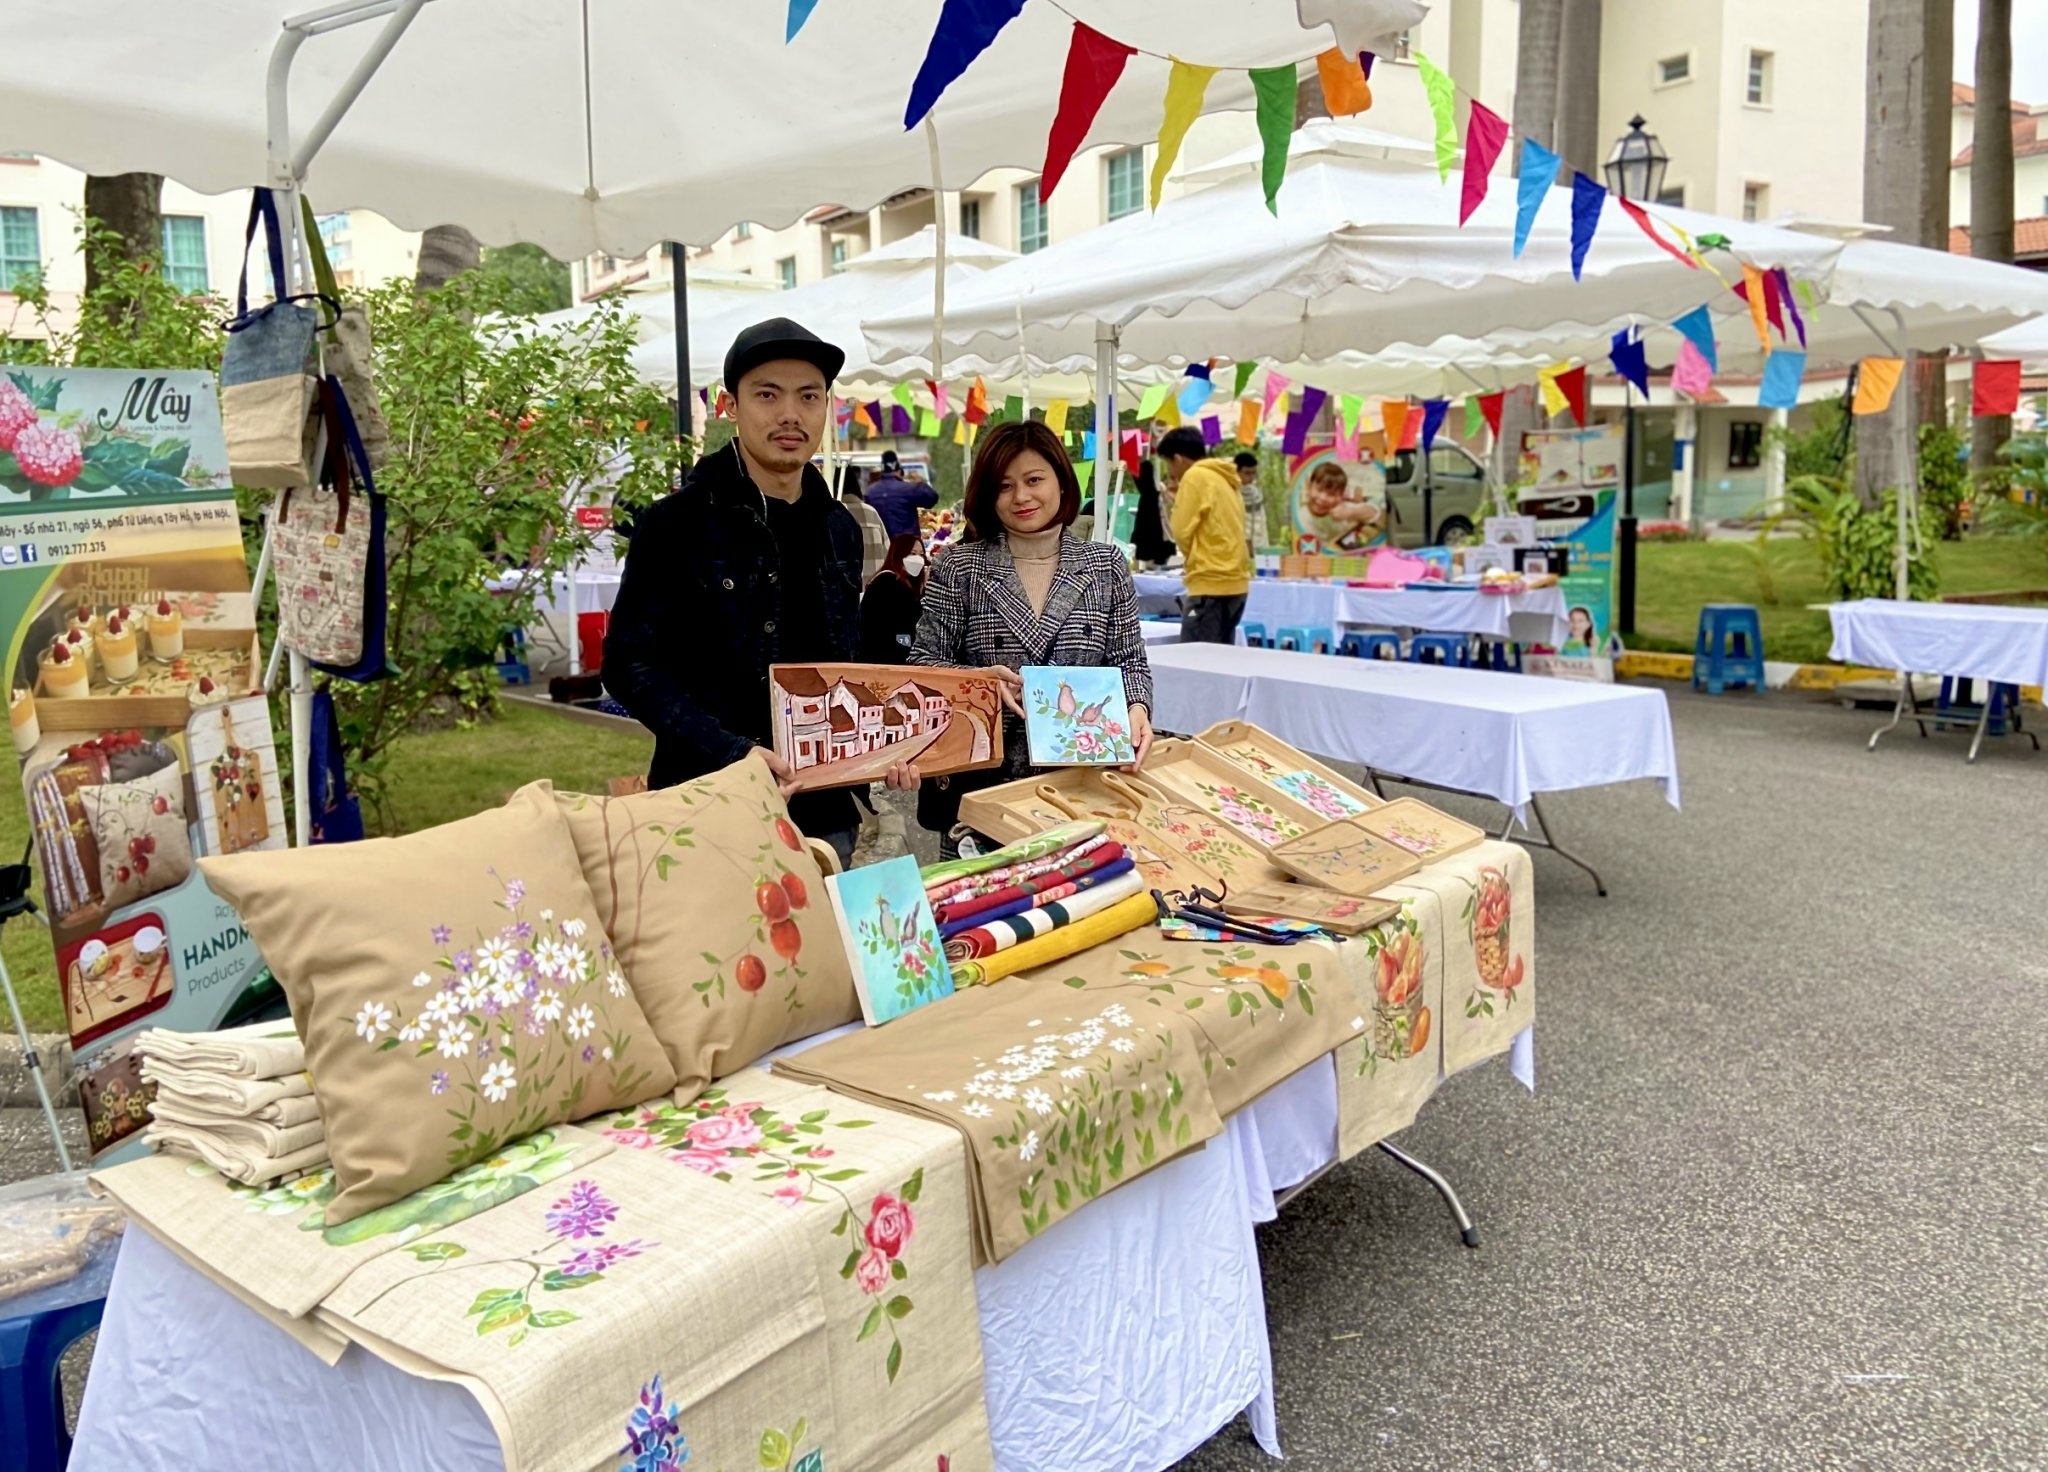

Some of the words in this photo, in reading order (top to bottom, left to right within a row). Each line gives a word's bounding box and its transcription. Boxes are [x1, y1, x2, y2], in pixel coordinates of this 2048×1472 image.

[97, 377, 191, 431] Mây
[23, 521, 35, 535] Số
[37, 521, 55, 534] nhà
[48, 541, 106, 557] 0912.777.375
[184, 923, 253, 970] HANDM
[188, 957, 246, 996] Products
